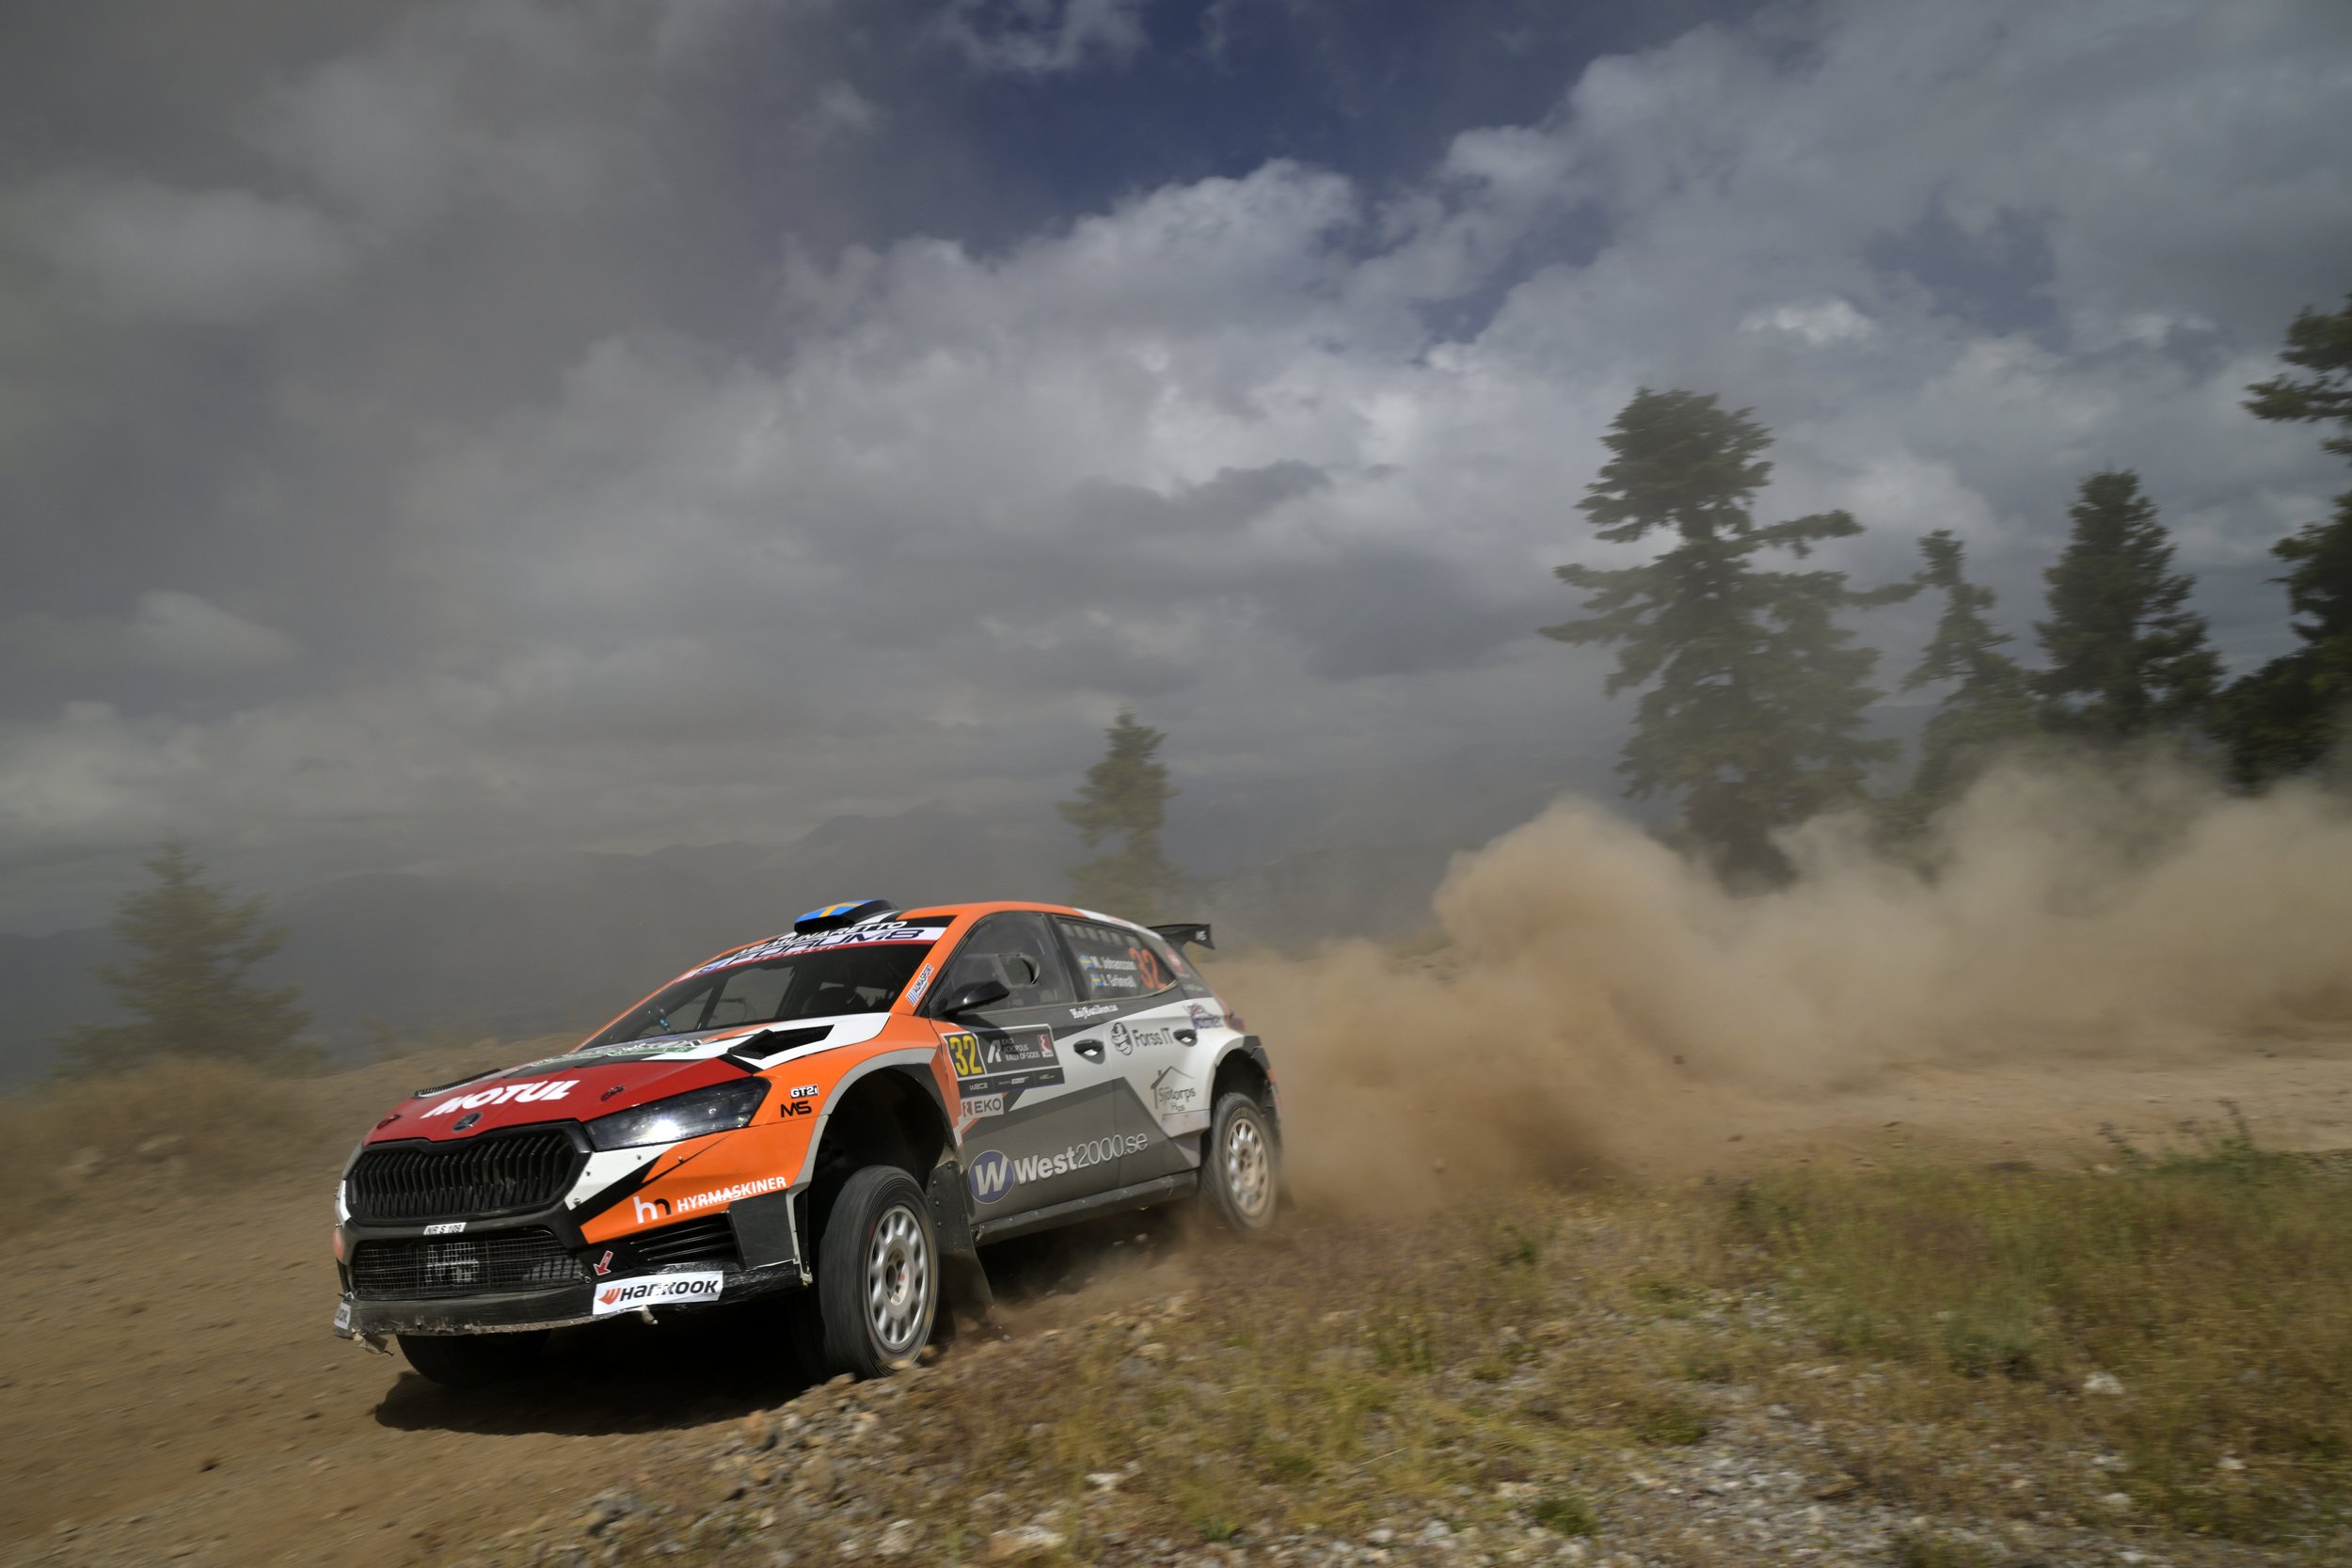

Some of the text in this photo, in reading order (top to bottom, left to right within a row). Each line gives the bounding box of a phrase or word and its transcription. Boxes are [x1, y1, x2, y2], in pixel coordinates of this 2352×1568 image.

[726, 928, 925, 966] FORUM8
[1129, 947, 1168, 989] 32
[949, 1036, 983, 1076] 32
[1133, 1027, 1173, 1047] Forss IT
[420, 1080, 580, 1119] MOTUL
[780, 1101, 812, 1117] MS
[974, 1098, 1002, 1114] EKO
[1012, 1132, 1149, 1186] West2000.se
[676, 1176, 787, 1212] HYRMASKINER
